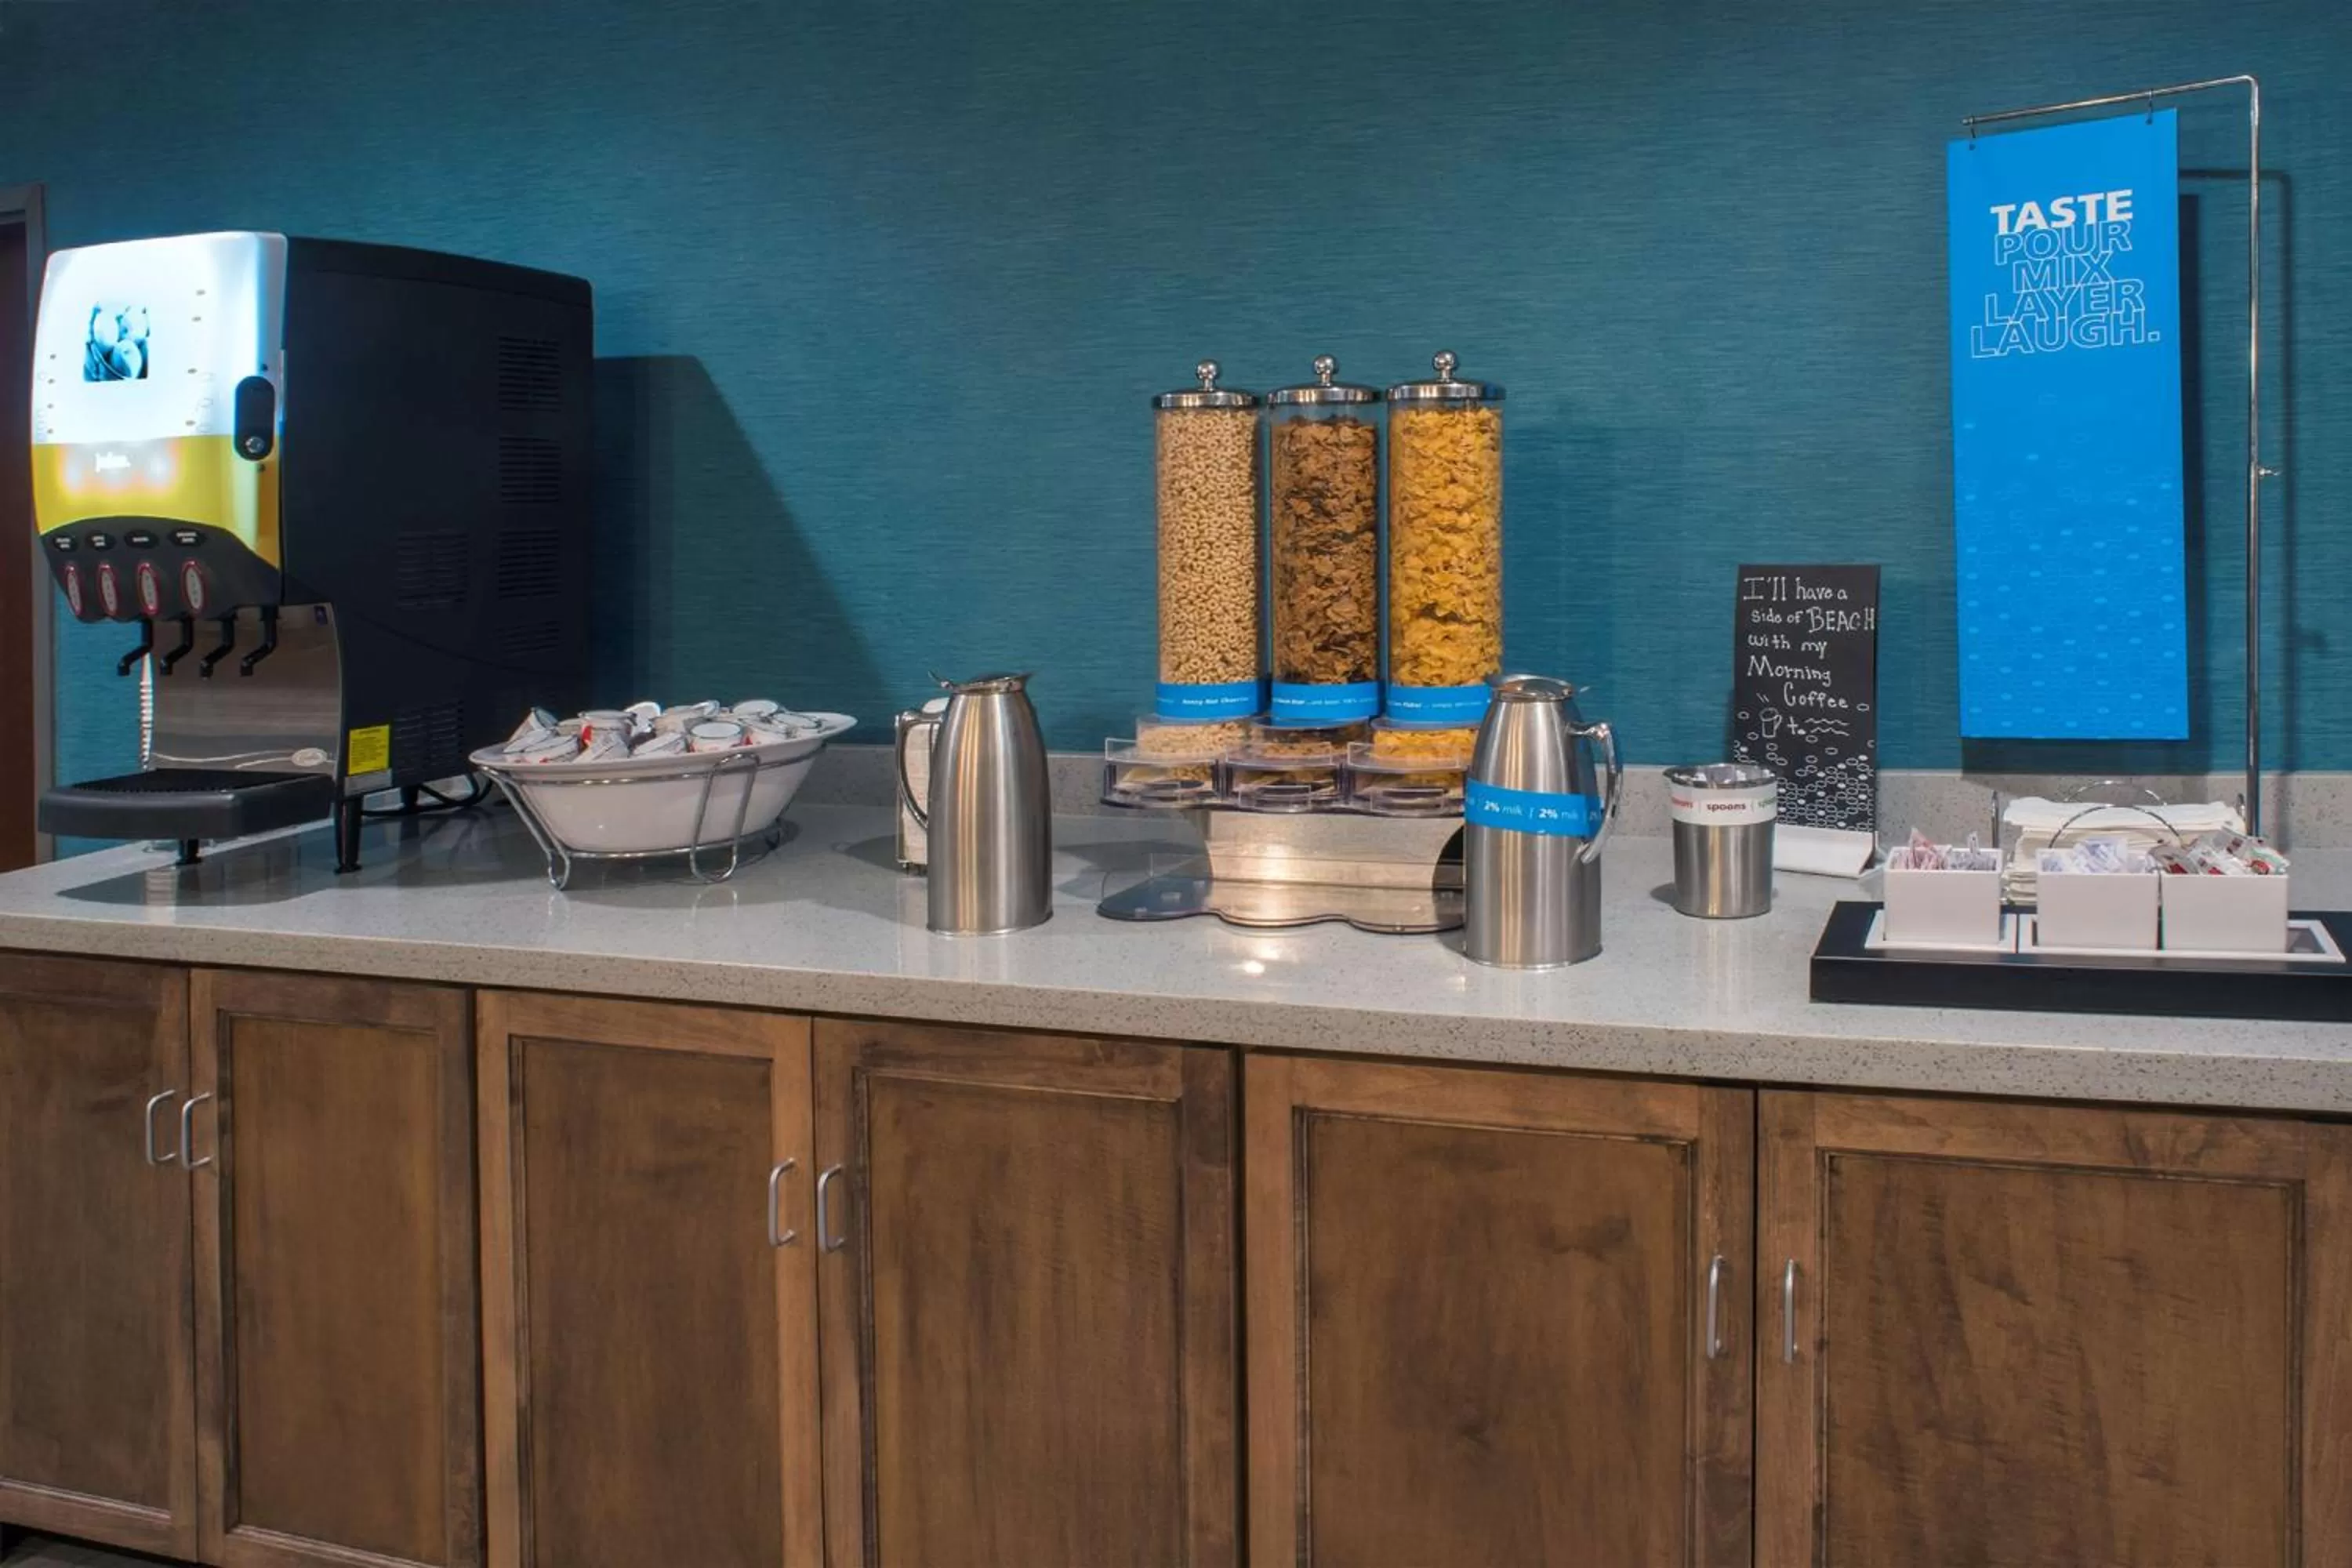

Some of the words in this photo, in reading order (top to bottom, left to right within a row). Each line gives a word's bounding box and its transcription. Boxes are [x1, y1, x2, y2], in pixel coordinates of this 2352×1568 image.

[1990, 188, 2133, 235] TASTE
[1994, 219, 2133, 266] POUR
[2013, 251, 2114, 294] MIX
[1984, 278, 2145, 327] LAYER
[1970, 310, 2161, 358] LAUGH.
[1743, 576, 1787, 601] I'll
[1795, 576, 1833, 601] have
[1837, 588, 1849, 601] a
[1751, 608, 1783, 624] side
[1787, 610, 1804, 624] of
[1806, 605, 1876, 633] BEACH
[1748, 633, 1791, 651] with
[1801, 641, 1828, 659] my
[1747, 655, 1832, 688] Morning
[1784, 681, 1849, 709] Coffee
[1483, 800, 1501, 813] 2%
[1538, 808, 1559, 820] 2%
[1707, 802, 1747, 813] spoons
